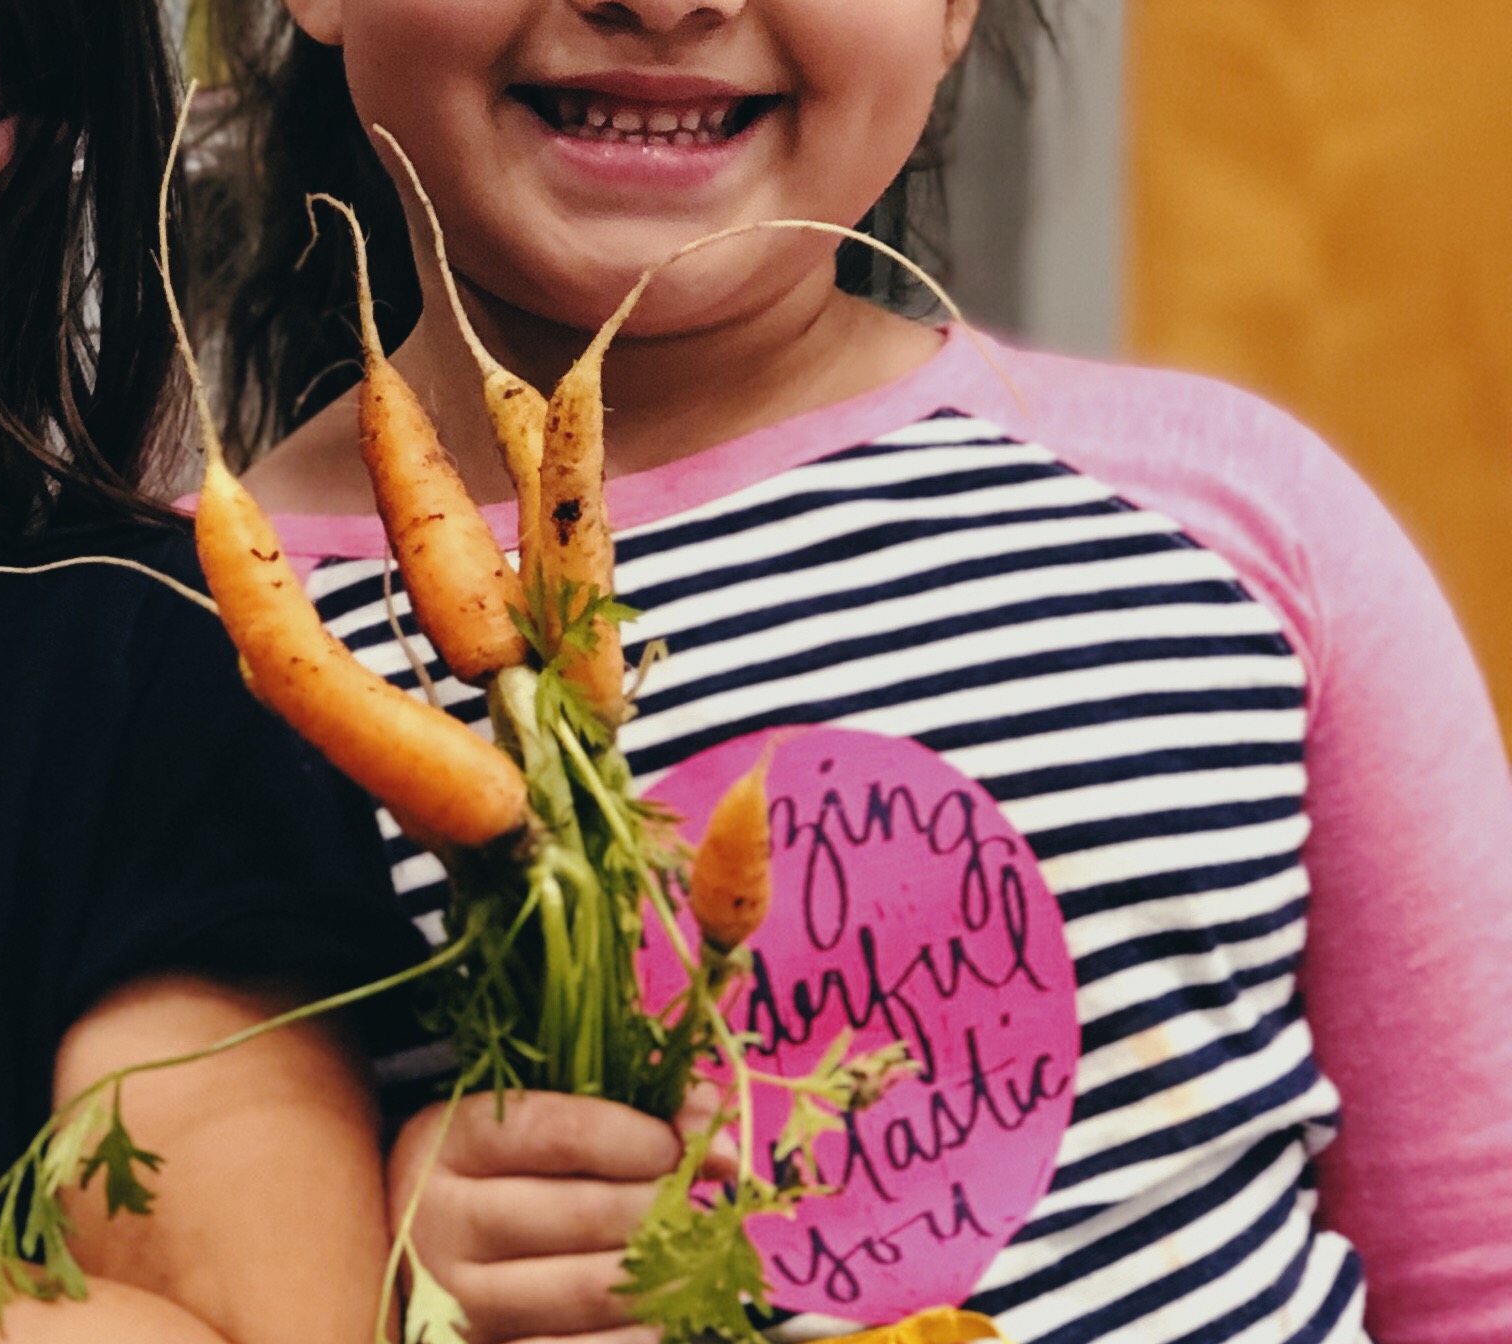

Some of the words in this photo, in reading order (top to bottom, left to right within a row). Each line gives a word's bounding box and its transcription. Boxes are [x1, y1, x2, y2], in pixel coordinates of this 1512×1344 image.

[769, 759, 1016, 951] zing
[724, 864, 1046, 1084] derful
[772, 1179, 995, 1304] you
